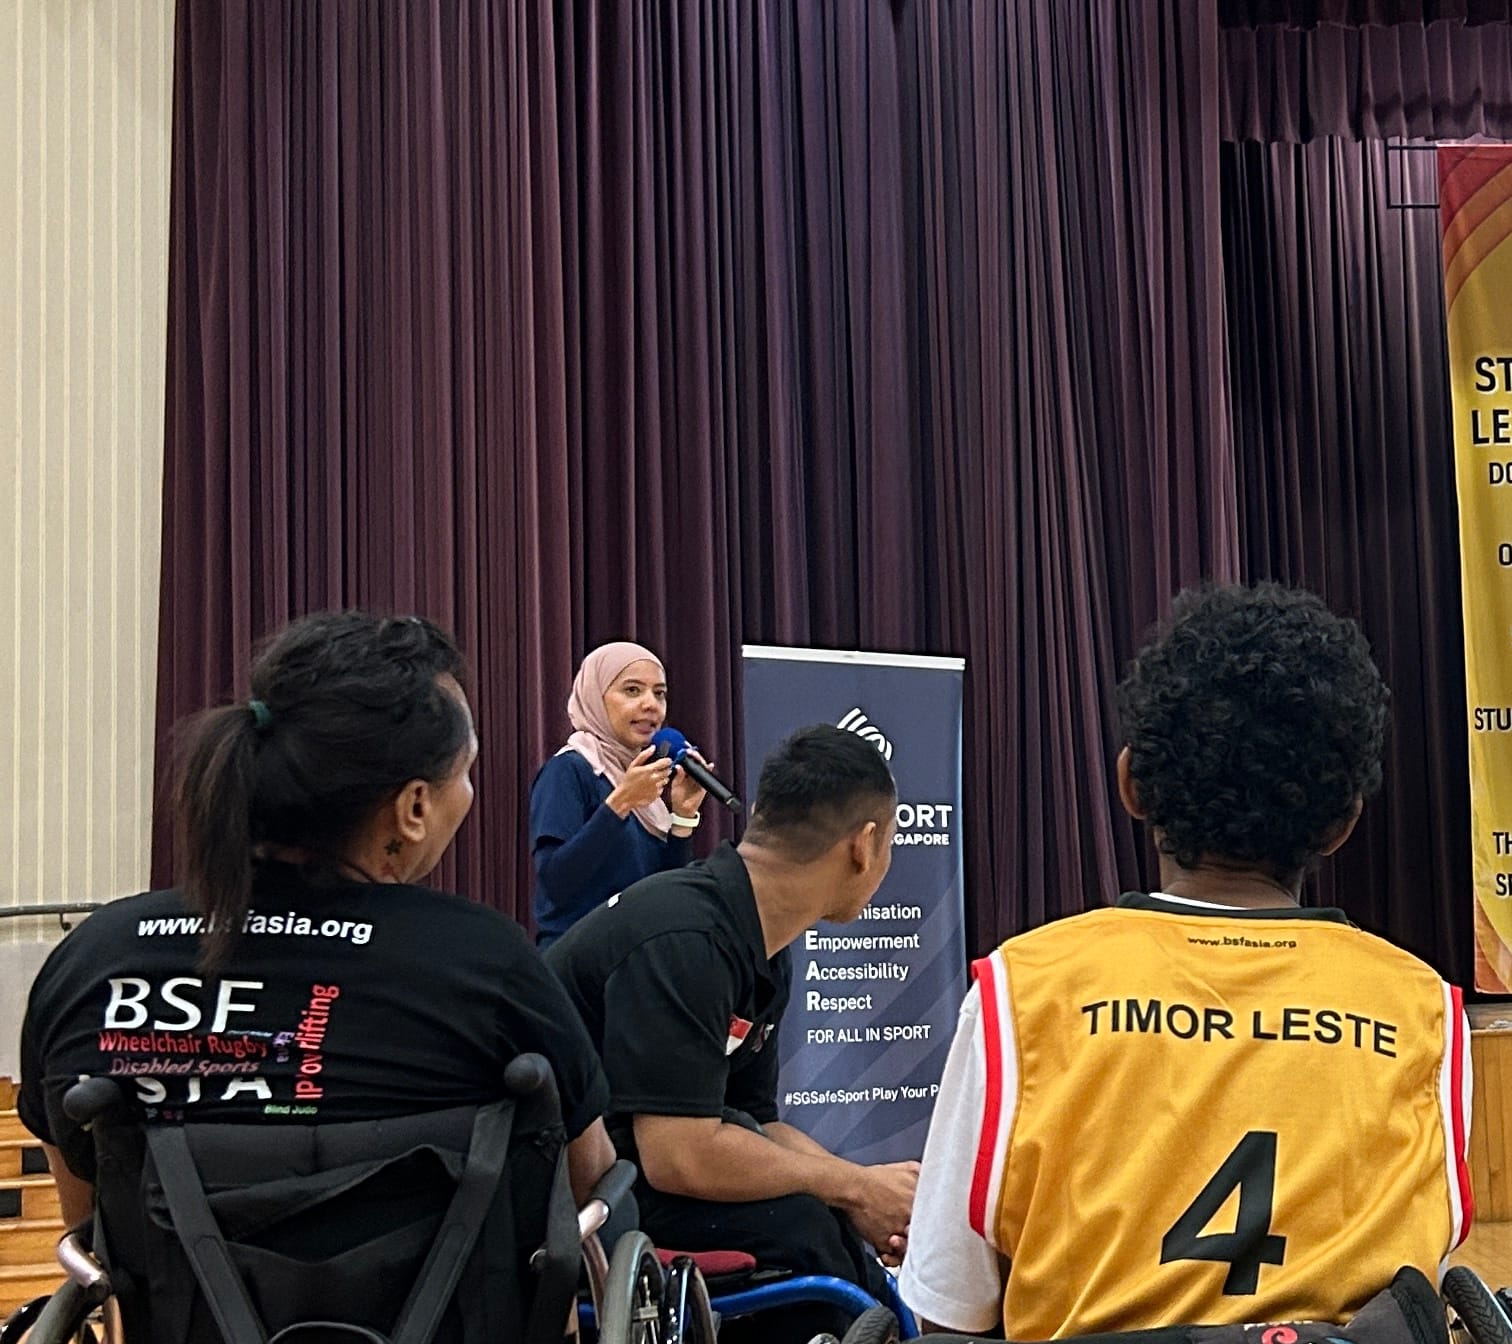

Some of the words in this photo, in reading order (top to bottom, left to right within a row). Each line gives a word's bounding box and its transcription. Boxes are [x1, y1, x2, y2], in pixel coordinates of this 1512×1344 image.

[896, 803, 953, 828] ORT
[890, 833, 950, 846] GAPORE
[805, 930, 920, 953] Empowerment
[1187, 936, 1297, 949] www.bsfasia.org
[805, 961, 909, 982] Accessibility
[104, 976, 264, 1033] BSF
[806, 991, 873, 1014] Respect
[807, 1028, 835, 1044] FOR
[837, 1028, 863, 1043] ALL
[865, 1027, 881, 1042] IN
[883, 1024, 931, 1041] SPORT
[1081, 998, 1236, 1043] TIMOR
[1251, 1006, 1398, 1059] LESTE
[98, 1030, 202, 1054] Wheelchair
[207, 1034, 268, 1059] Rugby
[110, 1057, 195, 1075] Disabled
[196, 1059, 261, 1077] Sports
[784, 1088, 870, 1106] #SGSafeSport
[872, 1086, 899, 1102] Play
[901, 1085, 928, 1099] Your
[263, 1103, 290, 1115] Blind
[1159, 1129, 1288, 1296] 4
